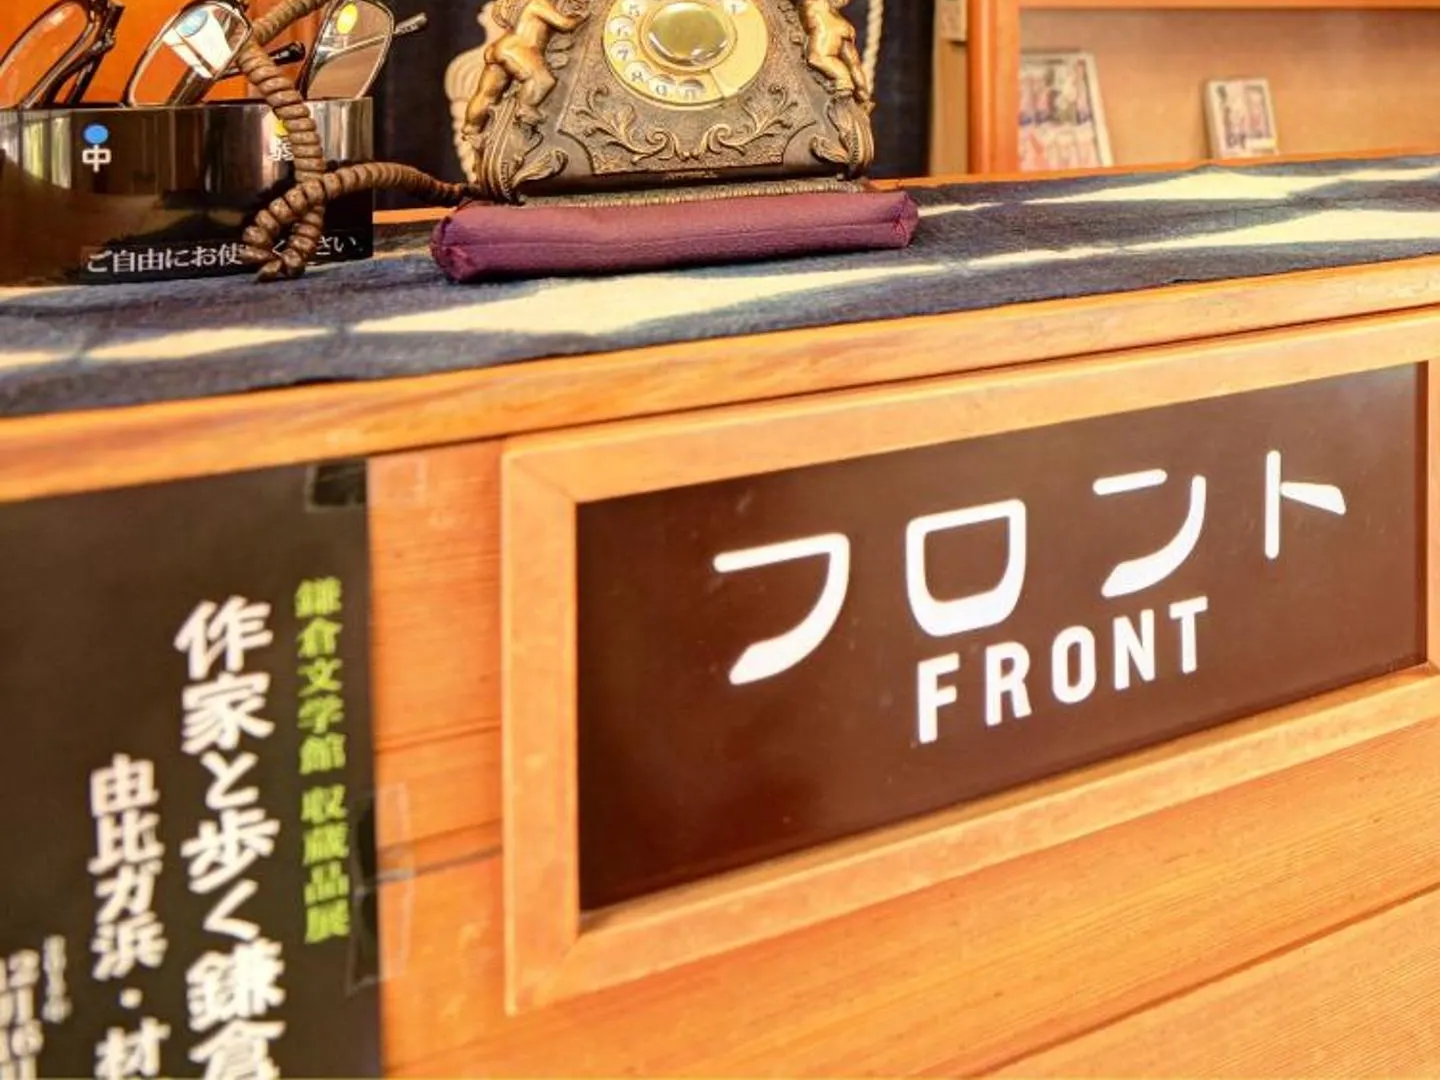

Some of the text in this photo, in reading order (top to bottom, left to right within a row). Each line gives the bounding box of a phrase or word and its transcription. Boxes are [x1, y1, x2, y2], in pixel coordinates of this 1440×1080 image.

[82, 145, 111, 172] 中
[713, 449, 1348, 686] フロント
[916, 595, 1210, 745] FRONT
